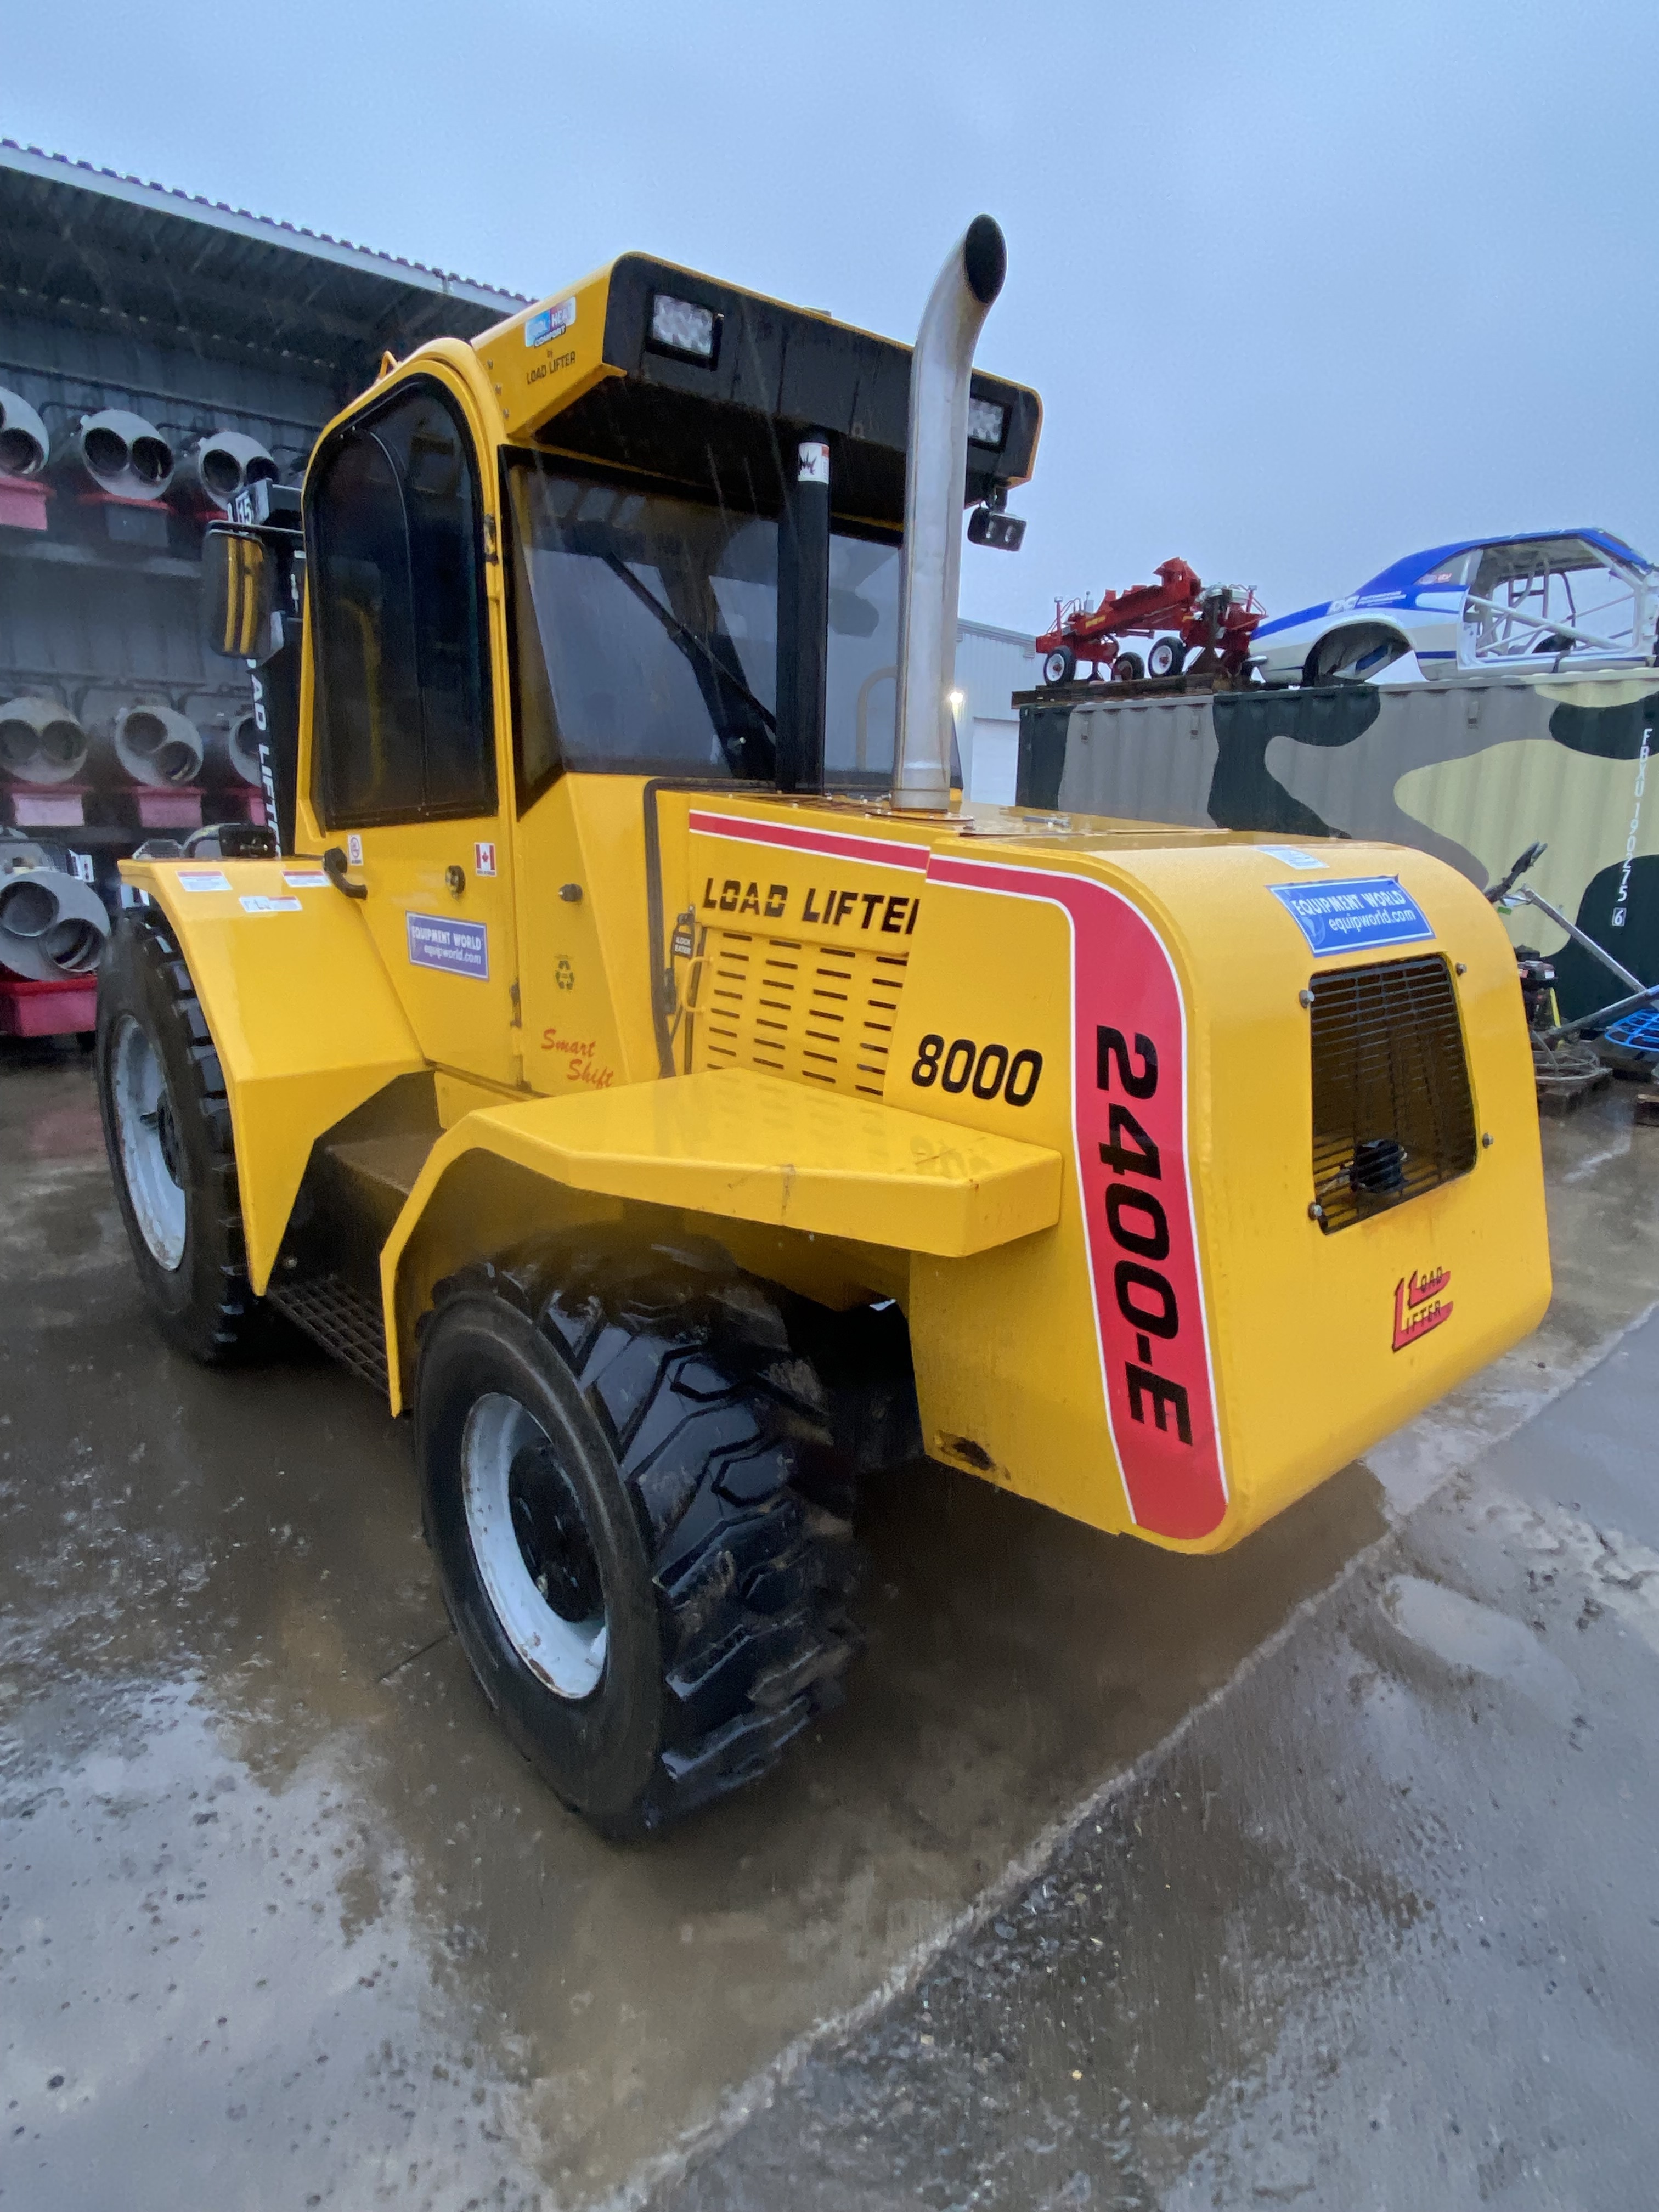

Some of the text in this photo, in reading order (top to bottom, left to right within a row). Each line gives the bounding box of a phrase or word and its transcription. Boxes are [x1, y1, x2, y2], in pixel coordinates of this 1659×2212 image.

[526, 351, 575, 385] LOAD LIFTER
[703, 878, 788, 918] LOAD
[1291, 890, 1407, 916] EQUIPMENT WORLD
[1329, 909, 1417, 934] equipworld.com
[411, 926, 482, 951] EQUIPMENT WORLD
[424, 945, 481, 965] equipworld.com
[541, 1028, 596, 1058] Smart
[567, 1058, 614, 1090] Shift
[912, 1034, 1043, 1107] 8000
[1097, 1025, 1192, 1446] 2400-E
